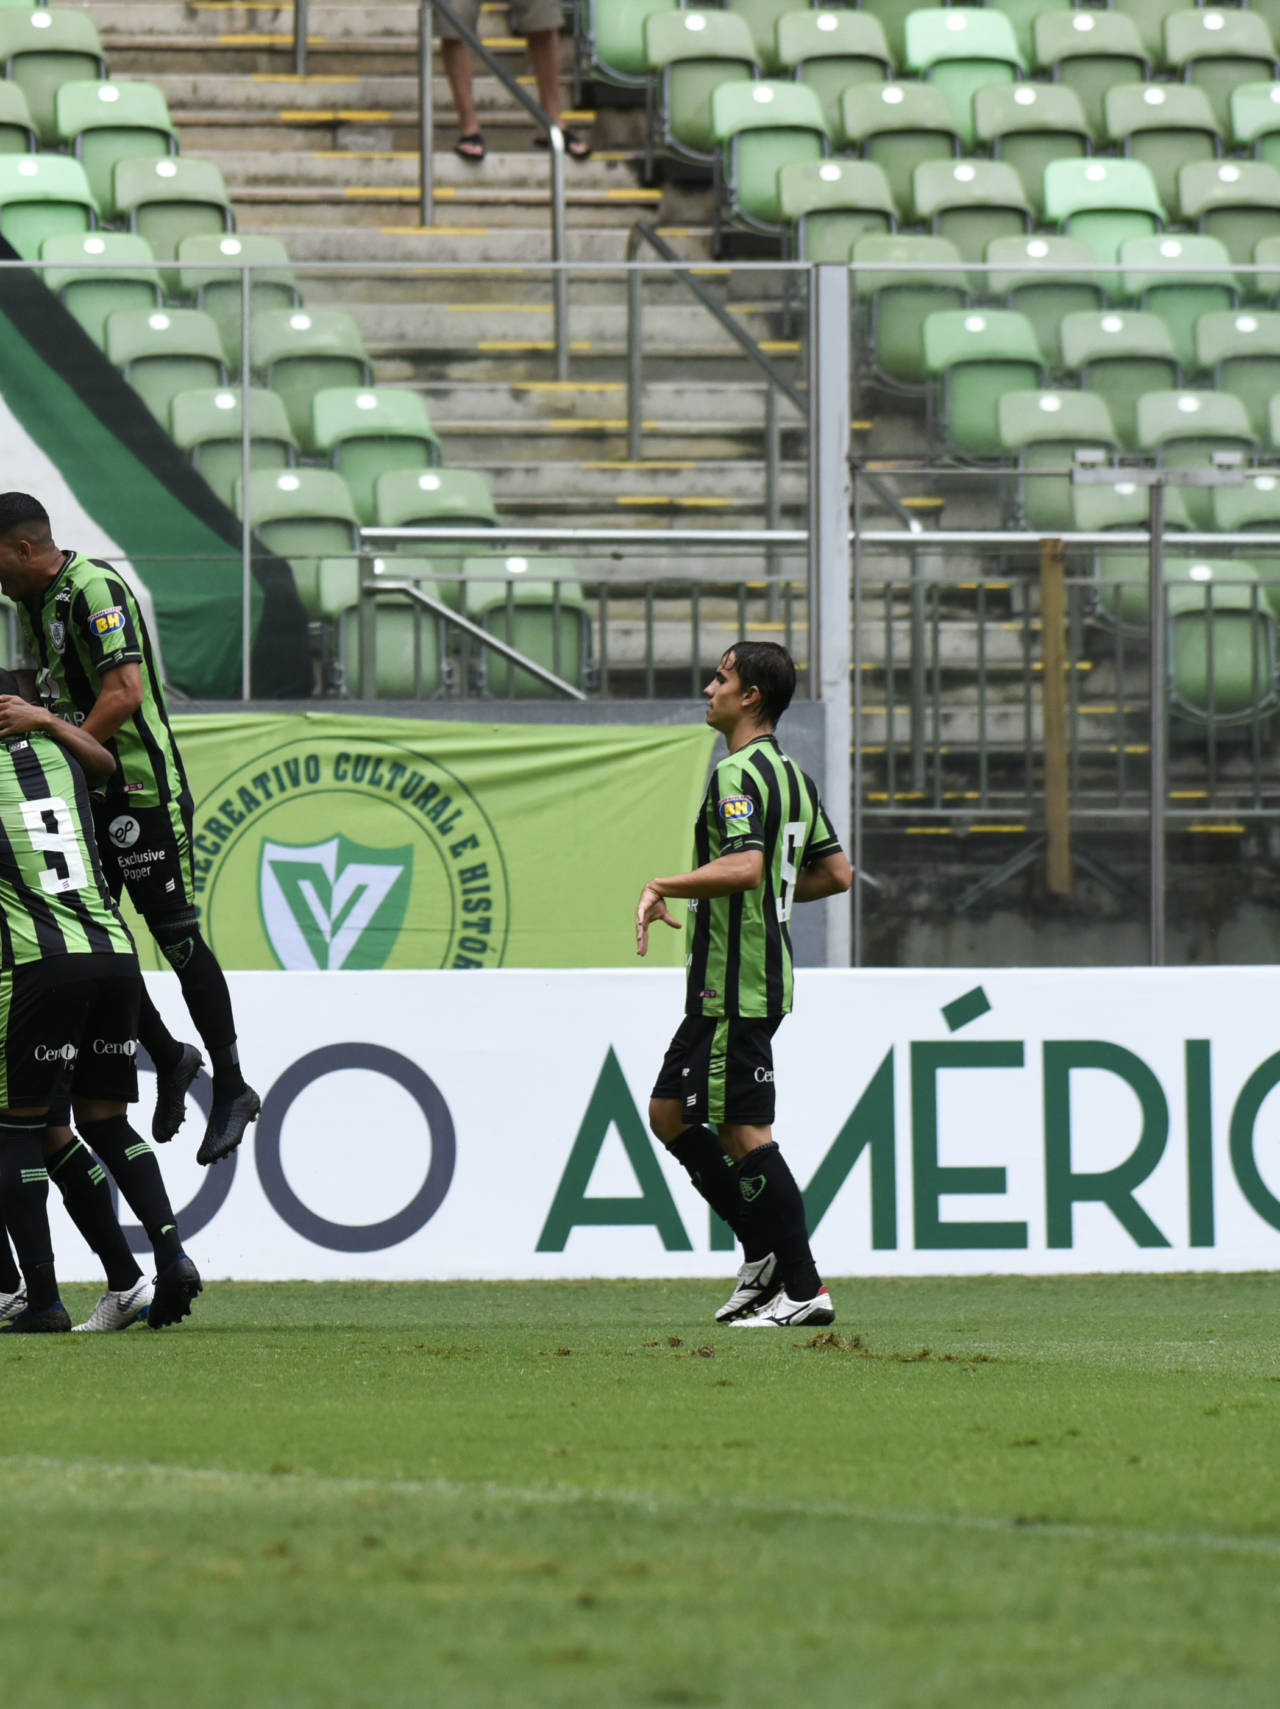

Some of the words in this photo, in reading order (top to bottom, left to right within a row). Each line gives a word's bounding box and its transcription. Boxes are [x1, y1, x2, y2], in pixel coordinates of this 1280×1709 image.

[96, 612, 120, 634] BH
[333, 752, 463, 837] CULTURAL
[449, 833, 480, 859] E
[724, 800, 749, 818] BH
[19, 796, 89, 894] 9
[117, 848, 166, 868] Exclusive
[123, 866, 152, 881] Paper
[776, 821, 808, 923] 5
